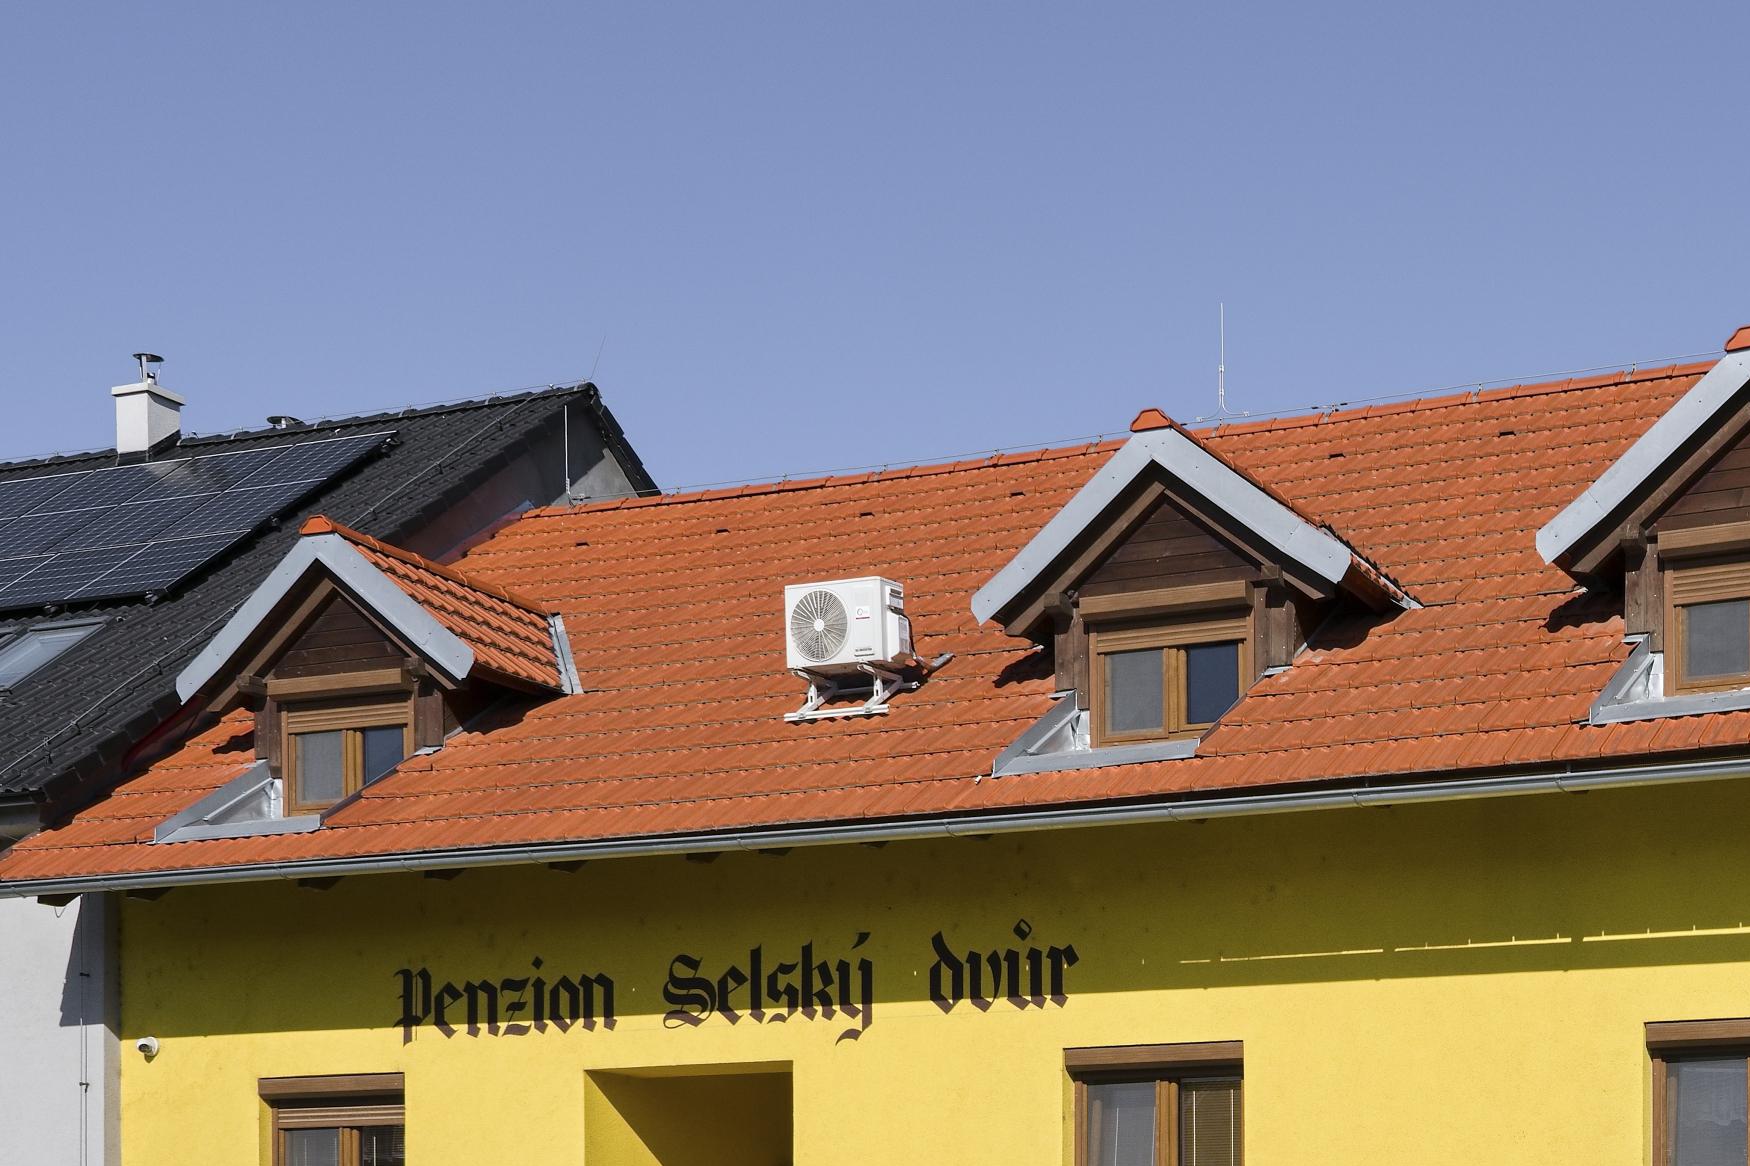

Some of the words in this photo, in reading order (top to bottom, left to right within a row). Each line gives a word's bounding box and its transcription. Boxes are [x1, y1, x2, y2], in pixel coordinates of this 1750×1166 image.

[392, 956, 618, 1047] Penzion
[662, 932, 875, 1046] Selský
[929, 918, 1080, 1013] dvůr
